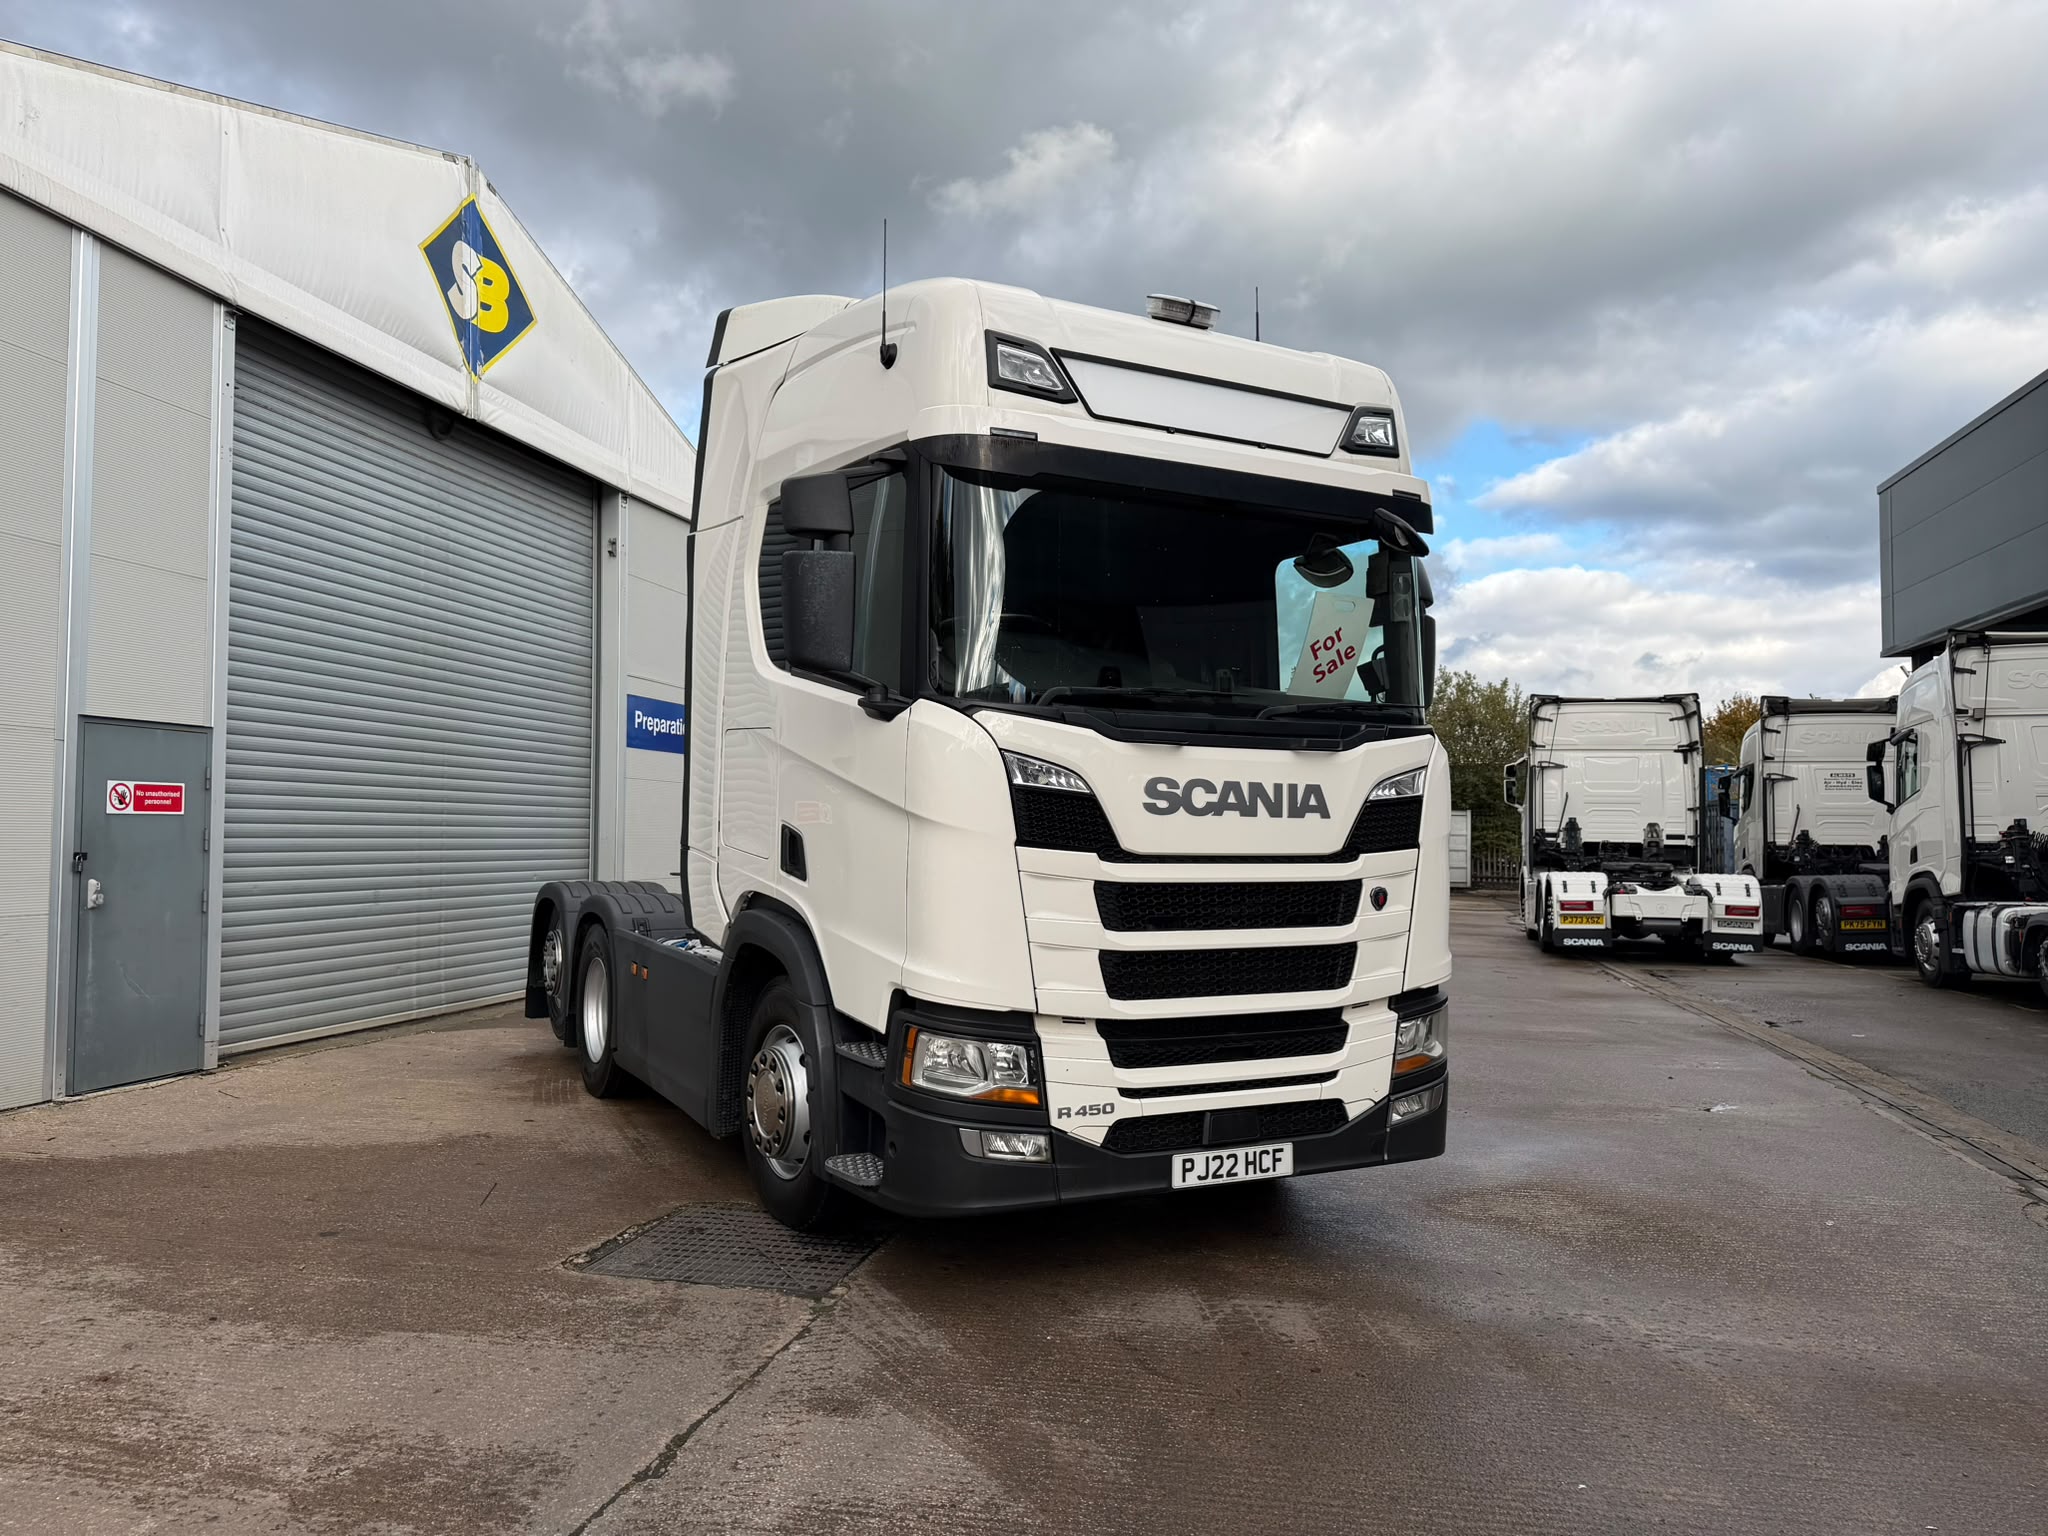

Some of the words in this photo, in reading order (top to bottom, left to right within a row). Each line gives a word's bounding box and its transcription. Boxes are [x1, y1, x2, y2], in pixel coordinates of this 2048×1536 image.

[447, 240, 511, 333] SB
[1309, 626, 1342, 661] For
[1312, 645, 1356, 684] Sale
[634, 710, 685, 737] Preparati
[1571, 719, 1654, 734] SCANIA
[144, 798, 172, 806] personnel
[145, 790, 180, 798] unauthorised
[1142, 776, 1331, 819] SCANIA
[1719, 920, 1753, 928] SCANIA
[1563, 937, 1604, 946] SCANIA
[1712, 942, 1754, 951] SCANIA
[1845, 943, 1887, 951] SCANIA
[1057, 1107, 1072, 1119] R
[1074, 1102, 1115, 1117] 450
[1181, 1153, 1238, 1183] PJ22
[1244, 1148, 1284, 1176] HCF
